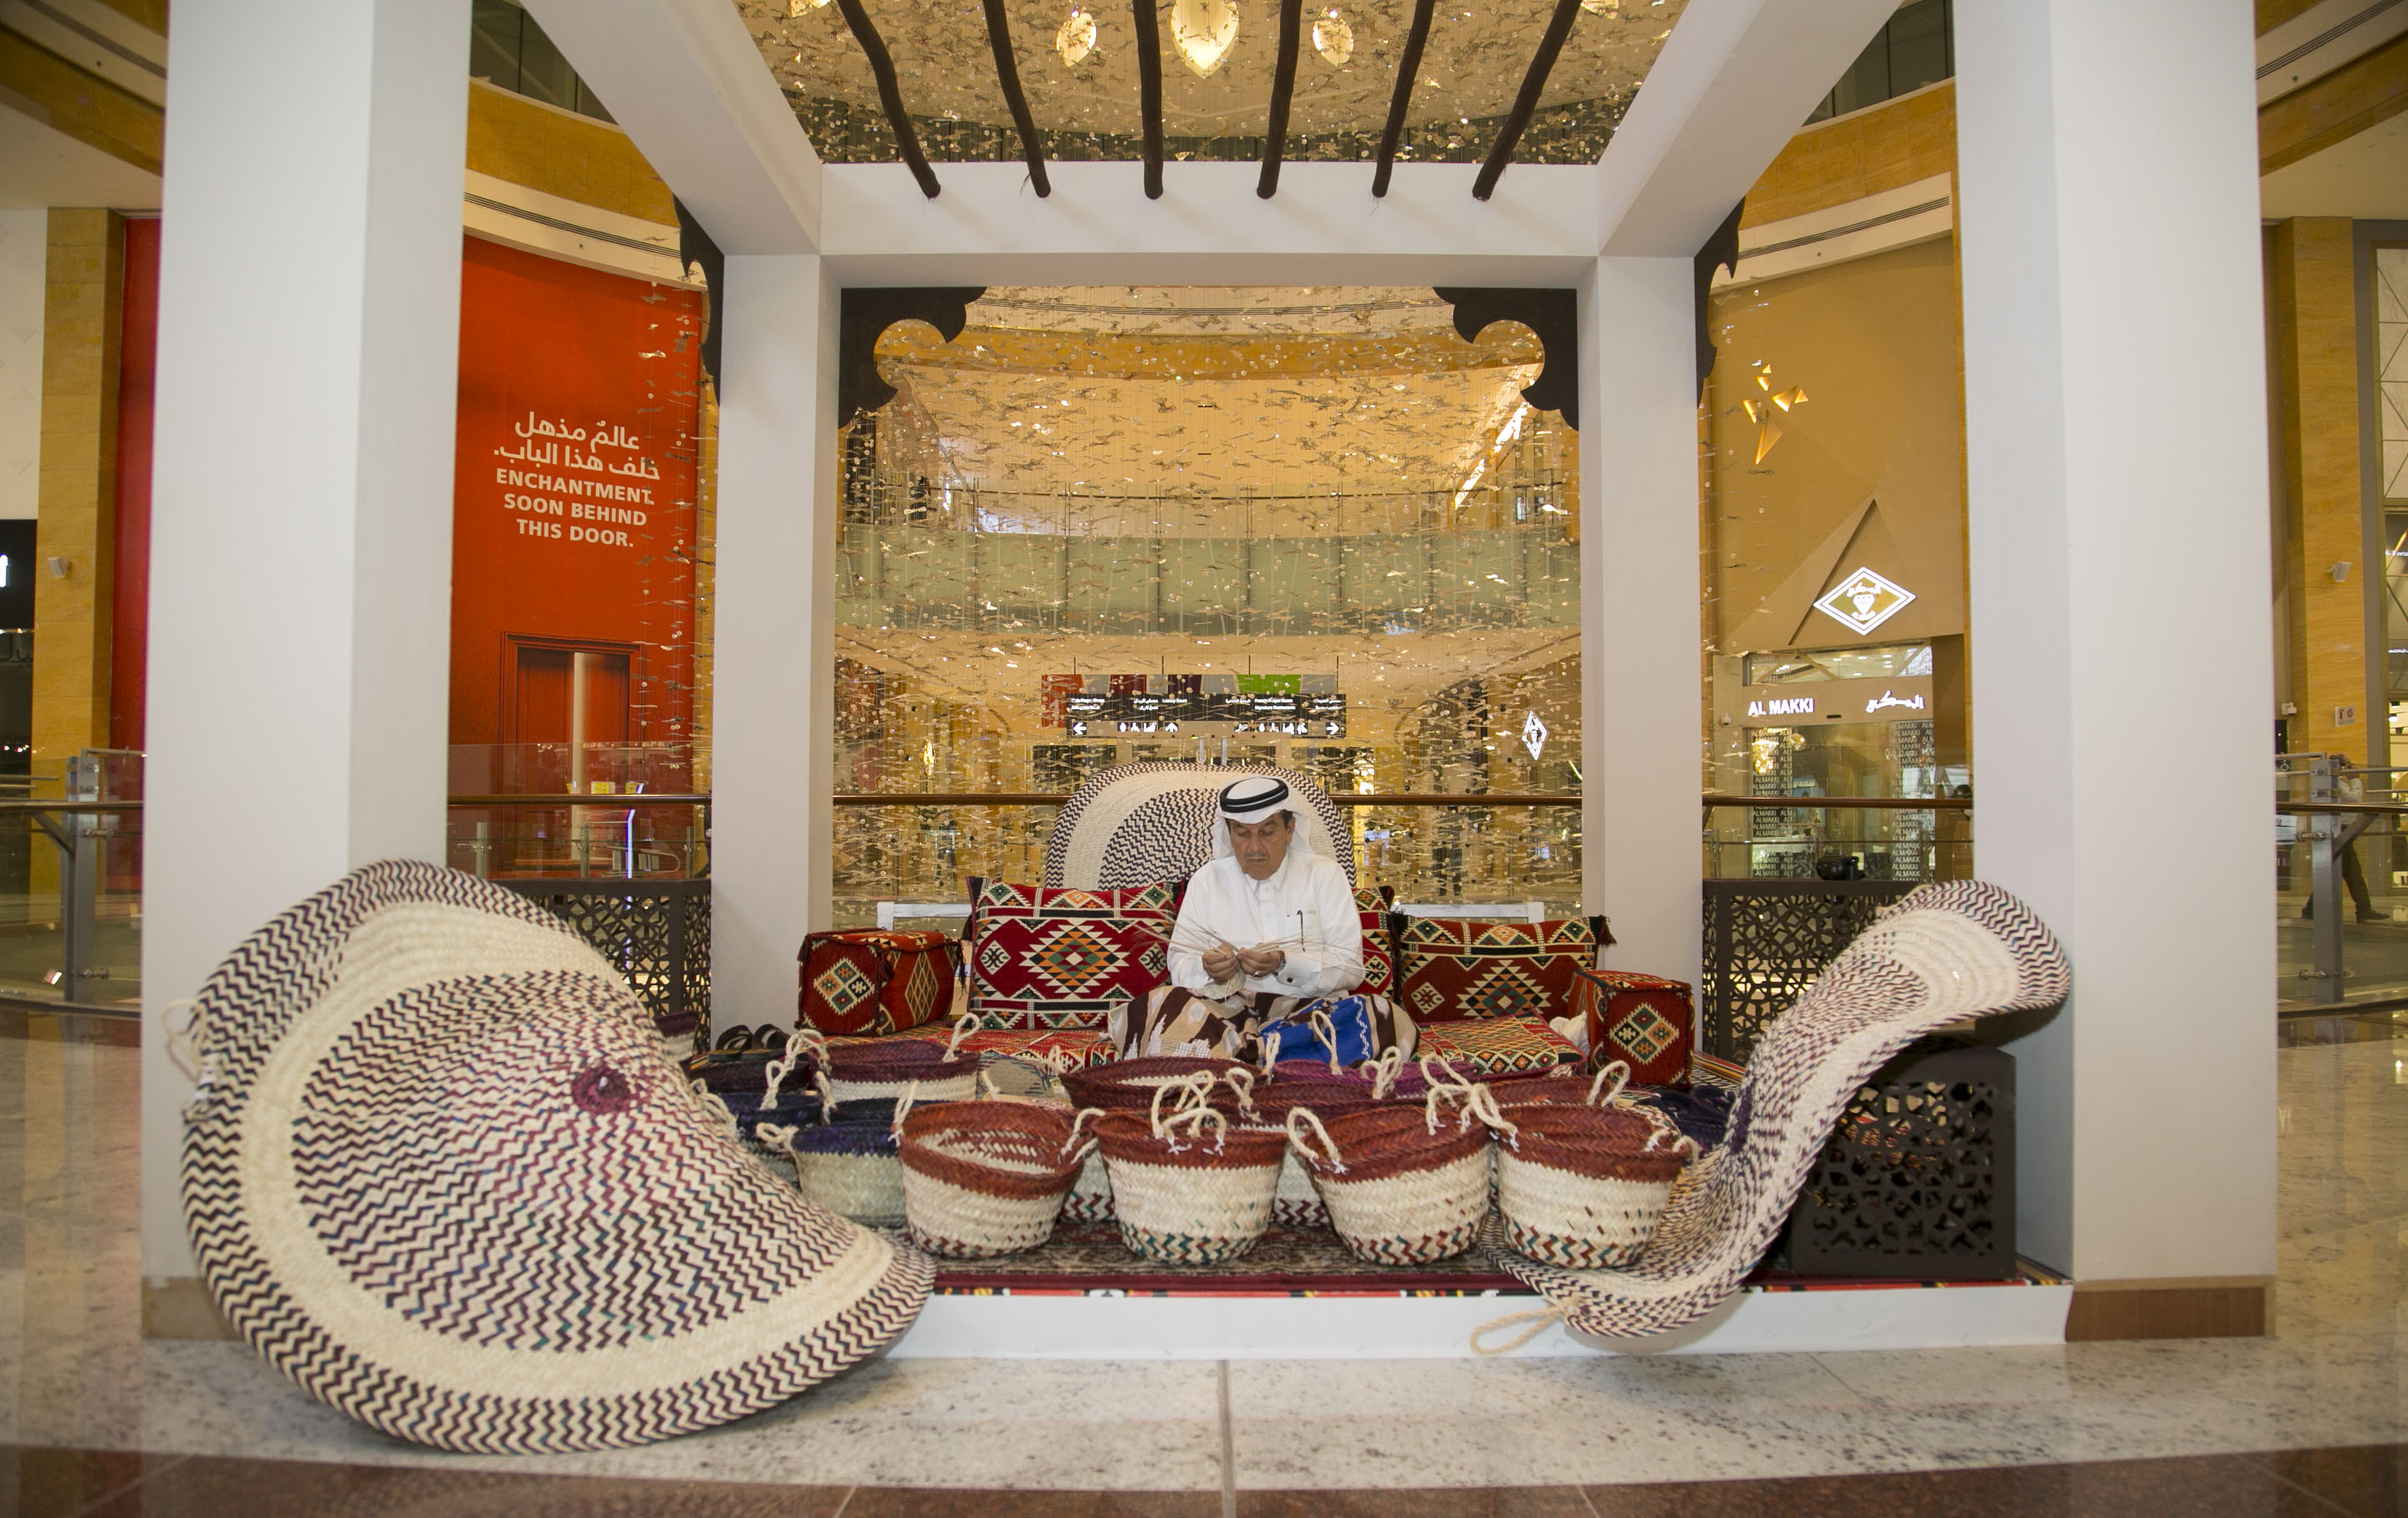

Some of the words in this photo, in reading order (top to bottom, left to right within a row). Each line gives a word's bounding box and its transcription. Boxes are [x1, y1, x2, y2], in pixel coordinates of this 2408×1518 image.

[515, 411, 586, 442] مذهل
[493, 440, 558, 468] الباب.
[564, 446, 604, 471] هذا
[608, 457, 661, 481] خلف
[497, 468, 655, 505] ENCHANTMENT.
[504, 493, 564, 516] SOON
[571, 503, 647, 526] BEHIND
[516, 519, 562, 539] THIS
[569, 525, 634, 547] DOOR.
[1747, 701, 1768, 717] AL
[1768, 698, 1814, 715] MAKKI
